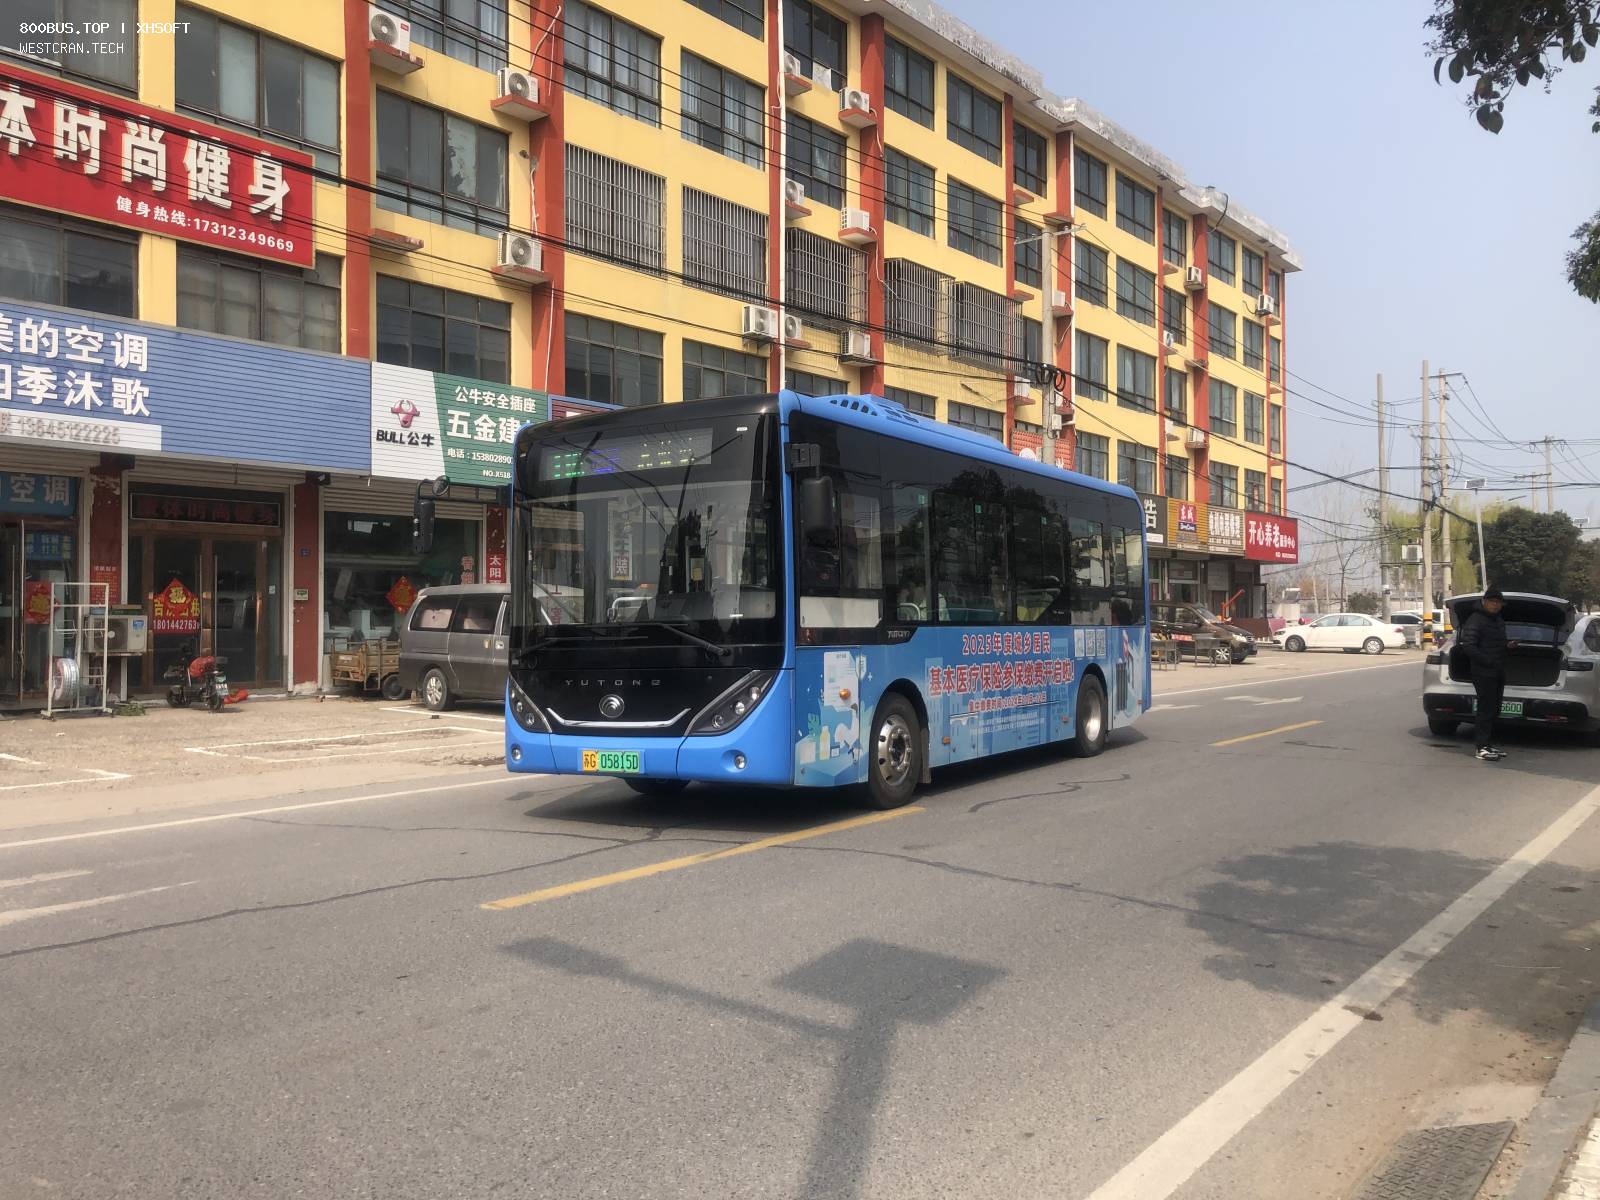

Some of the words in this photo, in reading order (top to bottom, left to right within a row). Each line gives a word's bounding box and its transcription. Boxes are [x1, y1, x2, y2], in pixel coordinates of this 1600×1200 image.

[0, 364, 151, 417] 季沐歌
[455, 385, 537, 414] 公牛安全插座
[446, 409, 532, 444] 五金建
[10, 474, 70, 506] 空调
